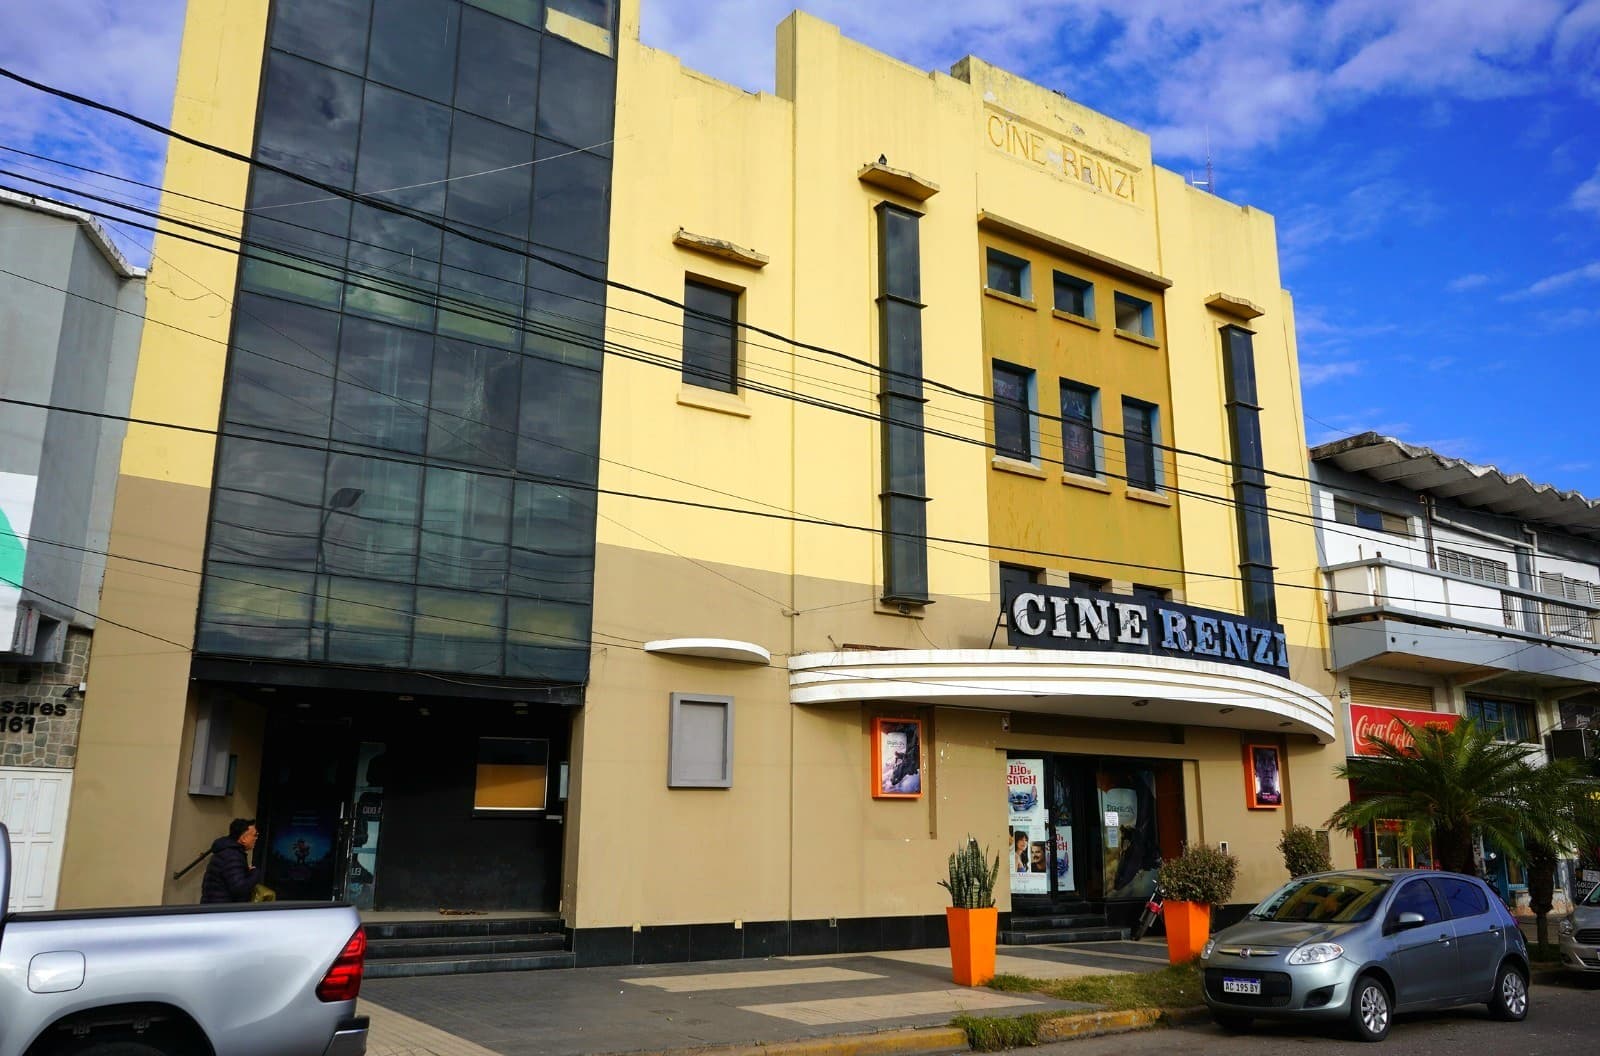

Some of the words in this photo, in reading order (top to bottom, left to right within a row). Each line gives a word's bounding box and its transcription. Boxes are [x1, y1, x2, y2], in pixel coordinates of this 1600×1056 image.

[988, 115, 1046, 165] CINE
[1062, 146, 1135, 202] RENZI
[1012, 593, 1149, 645] CINE
[1158, 608, 1289, 668] RENZI
[0, 716, 36, 733] 161
[1225, 983, 1234, 991] AC
[1236, 983, 1249, 992] 195
[1250, 984, 1258, 993] BY
